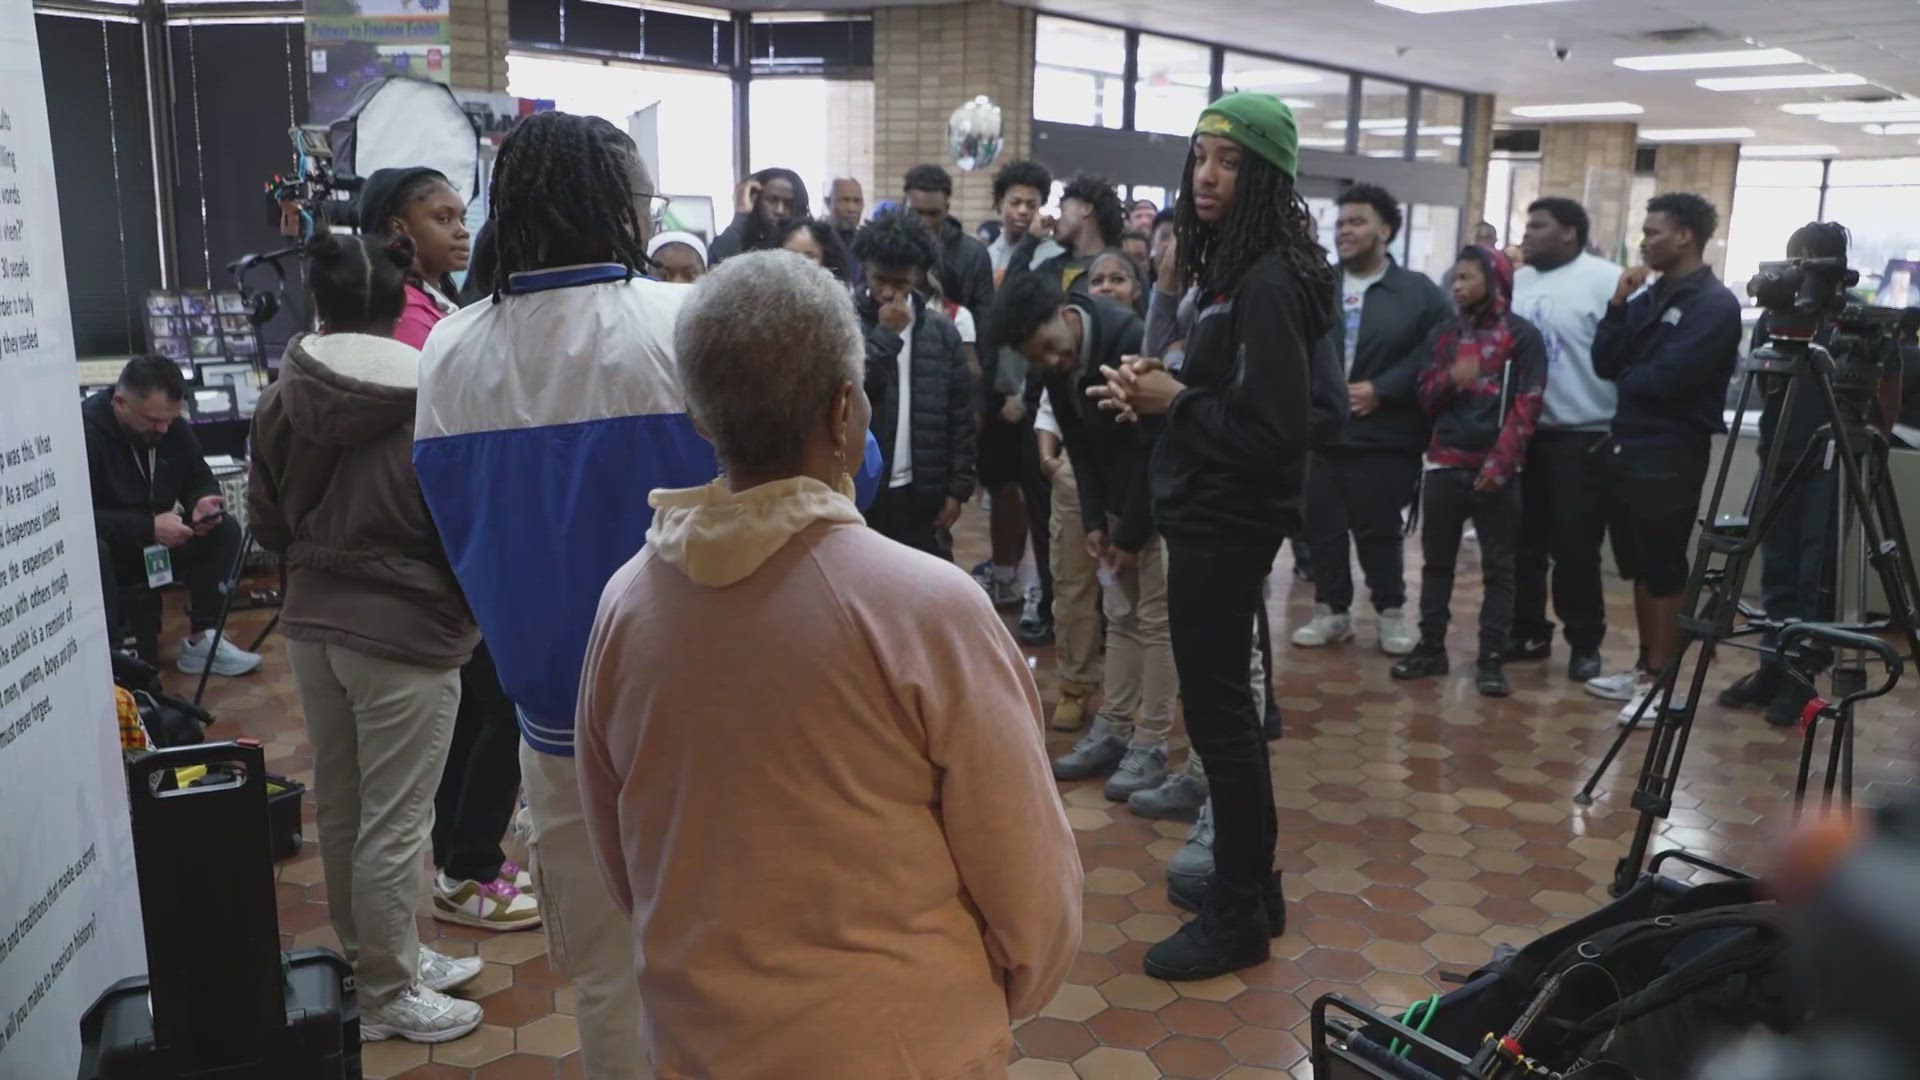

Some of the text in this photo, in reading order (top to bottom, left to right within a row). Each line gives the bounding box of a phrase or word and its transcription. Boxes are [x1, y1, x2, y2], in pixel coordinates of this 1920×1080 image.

[5, 448, 20, 467] was
[5, 484, 15, 506] As
[30, 585, 51, 609] others
[43, 653, 60, 677] boys
[58, 864, 75, 894] made
[15, 1002, 27, 1032] you
